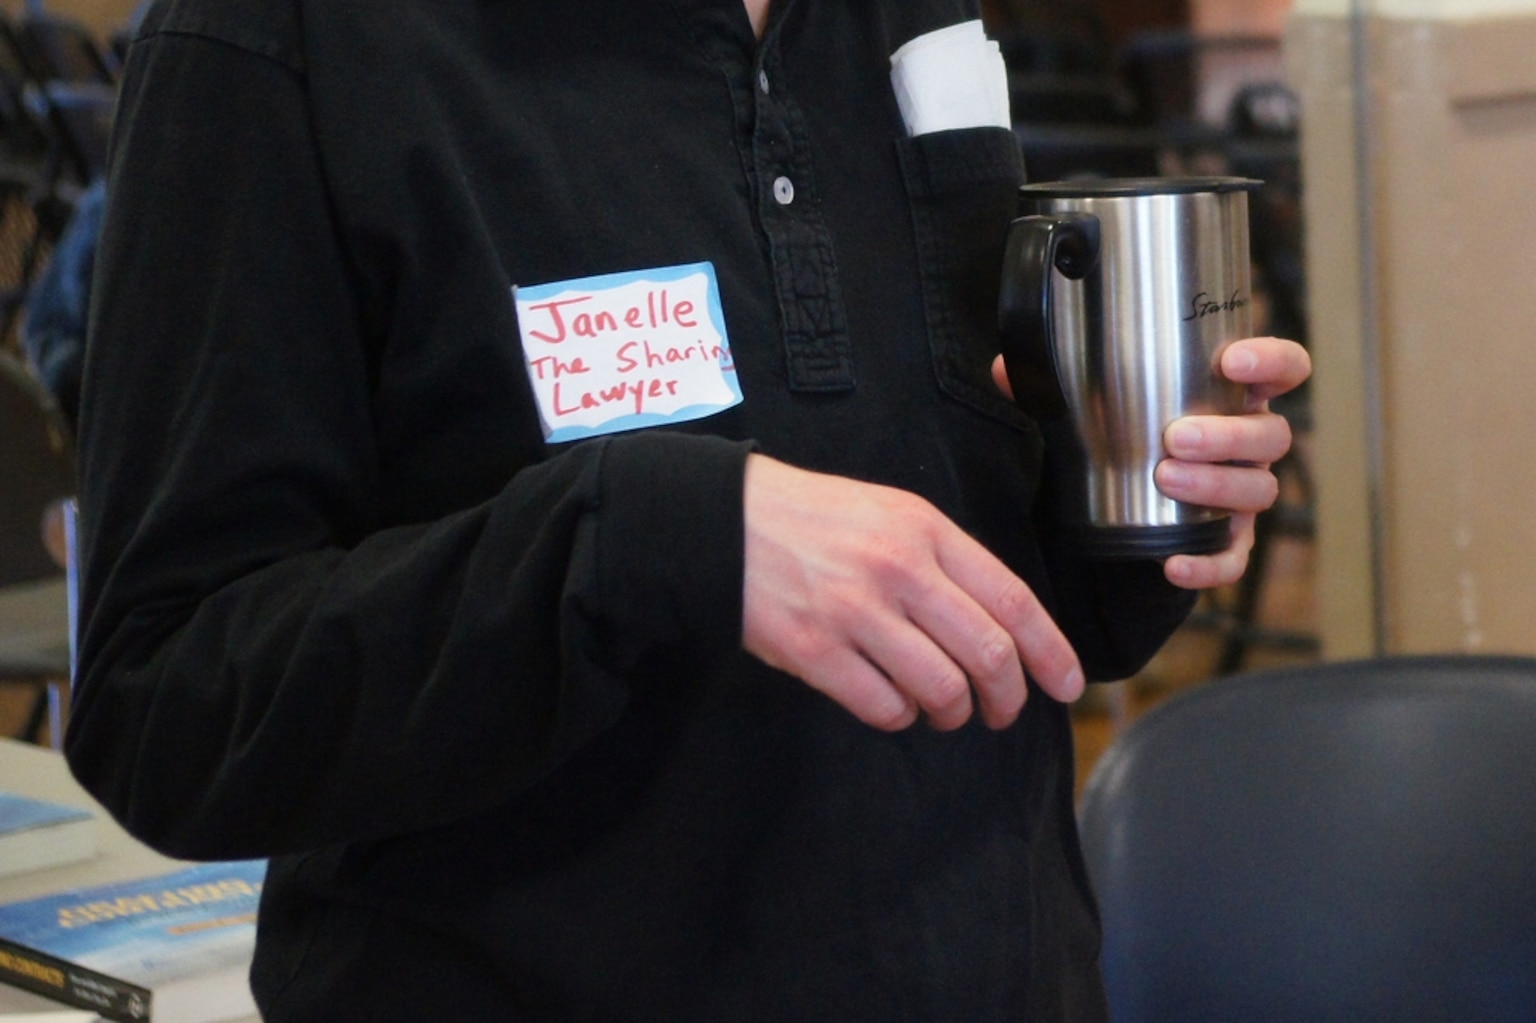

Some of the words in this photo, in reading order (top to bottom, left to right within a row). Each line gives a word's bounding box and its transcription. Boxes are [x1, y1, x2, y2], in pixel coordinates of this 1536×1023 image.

[528, 289, 698, 344] Janelle
[530, 355, 590, 380] The
[553, 378, 678, 416] Lawyer
